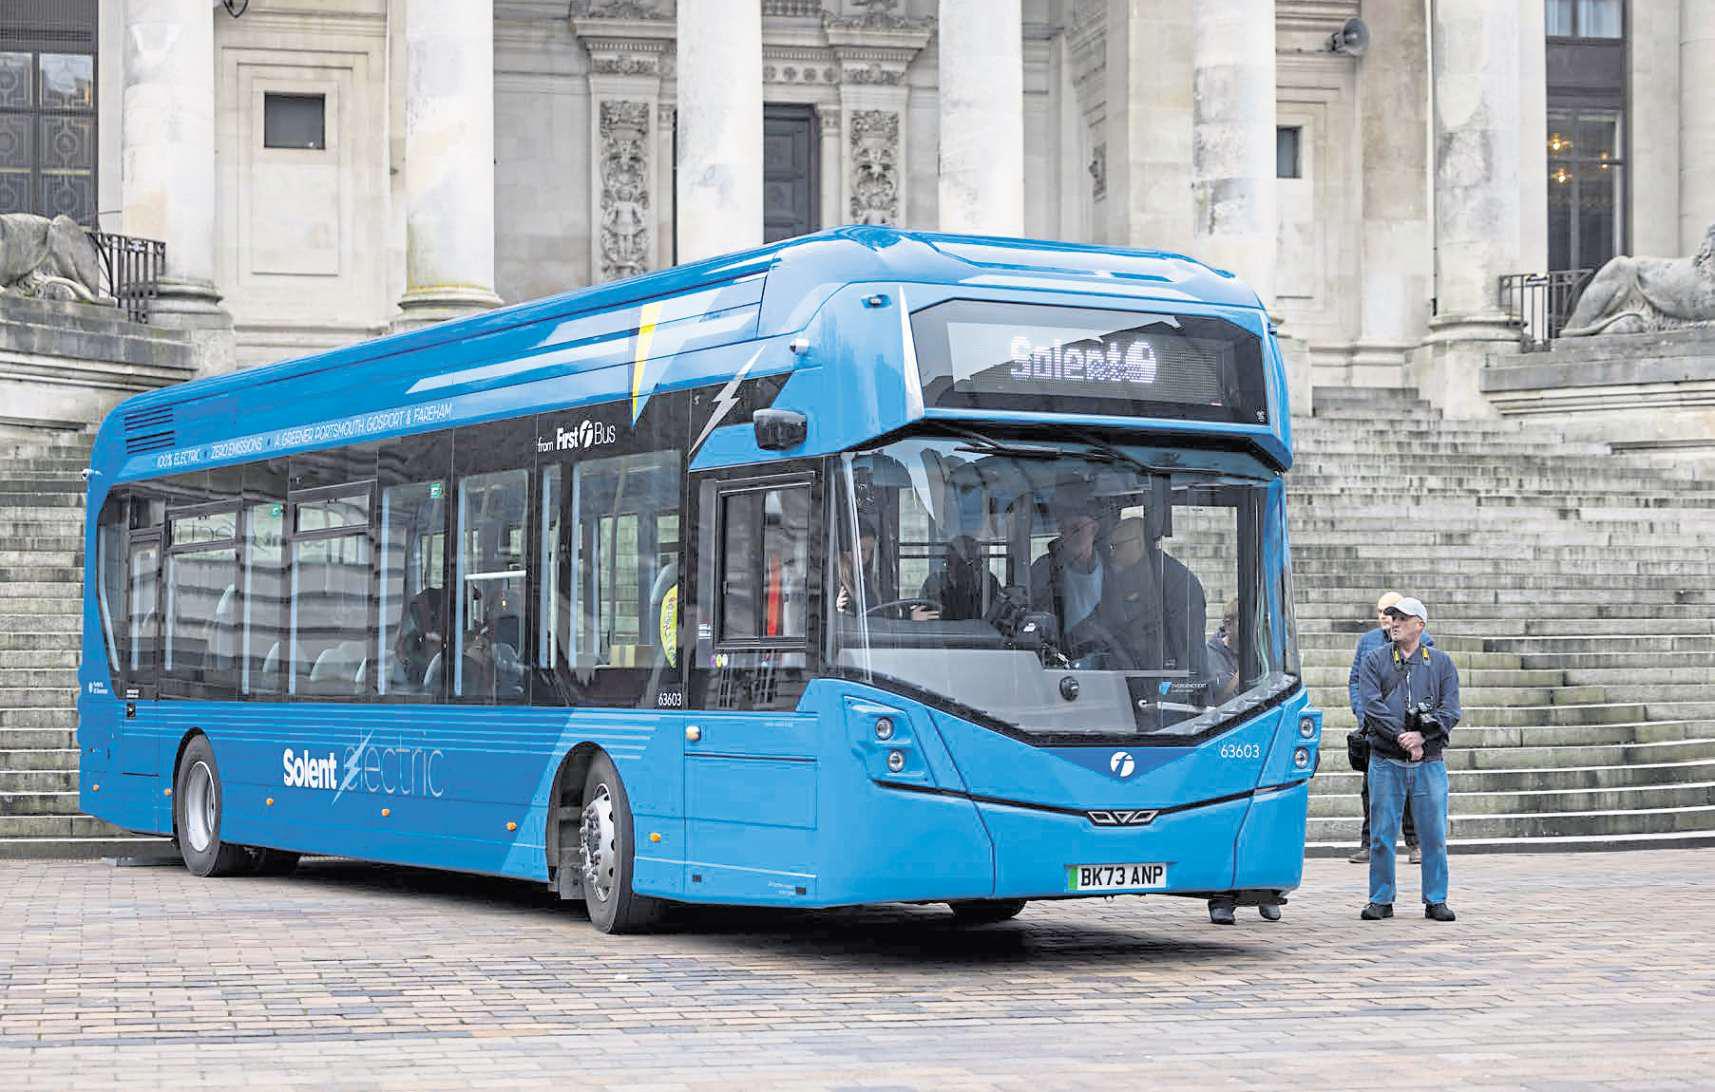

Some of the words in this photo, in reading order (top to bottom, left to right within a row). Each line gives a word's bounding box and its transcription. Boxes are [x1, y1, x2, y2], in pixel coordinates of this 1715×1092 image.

[537, 436, 554, 453] from
[556, 426, 578, 451] First
[594, 421, 616, 445] Bus
[658, 691, 682, 706] 63603
[1220, 744, 1260, 758] 63603
[283, 748, 337, 790] Solent
[1080, 867, 1126, 887] BK73
[1131, 865, 1163, 886] ANP
